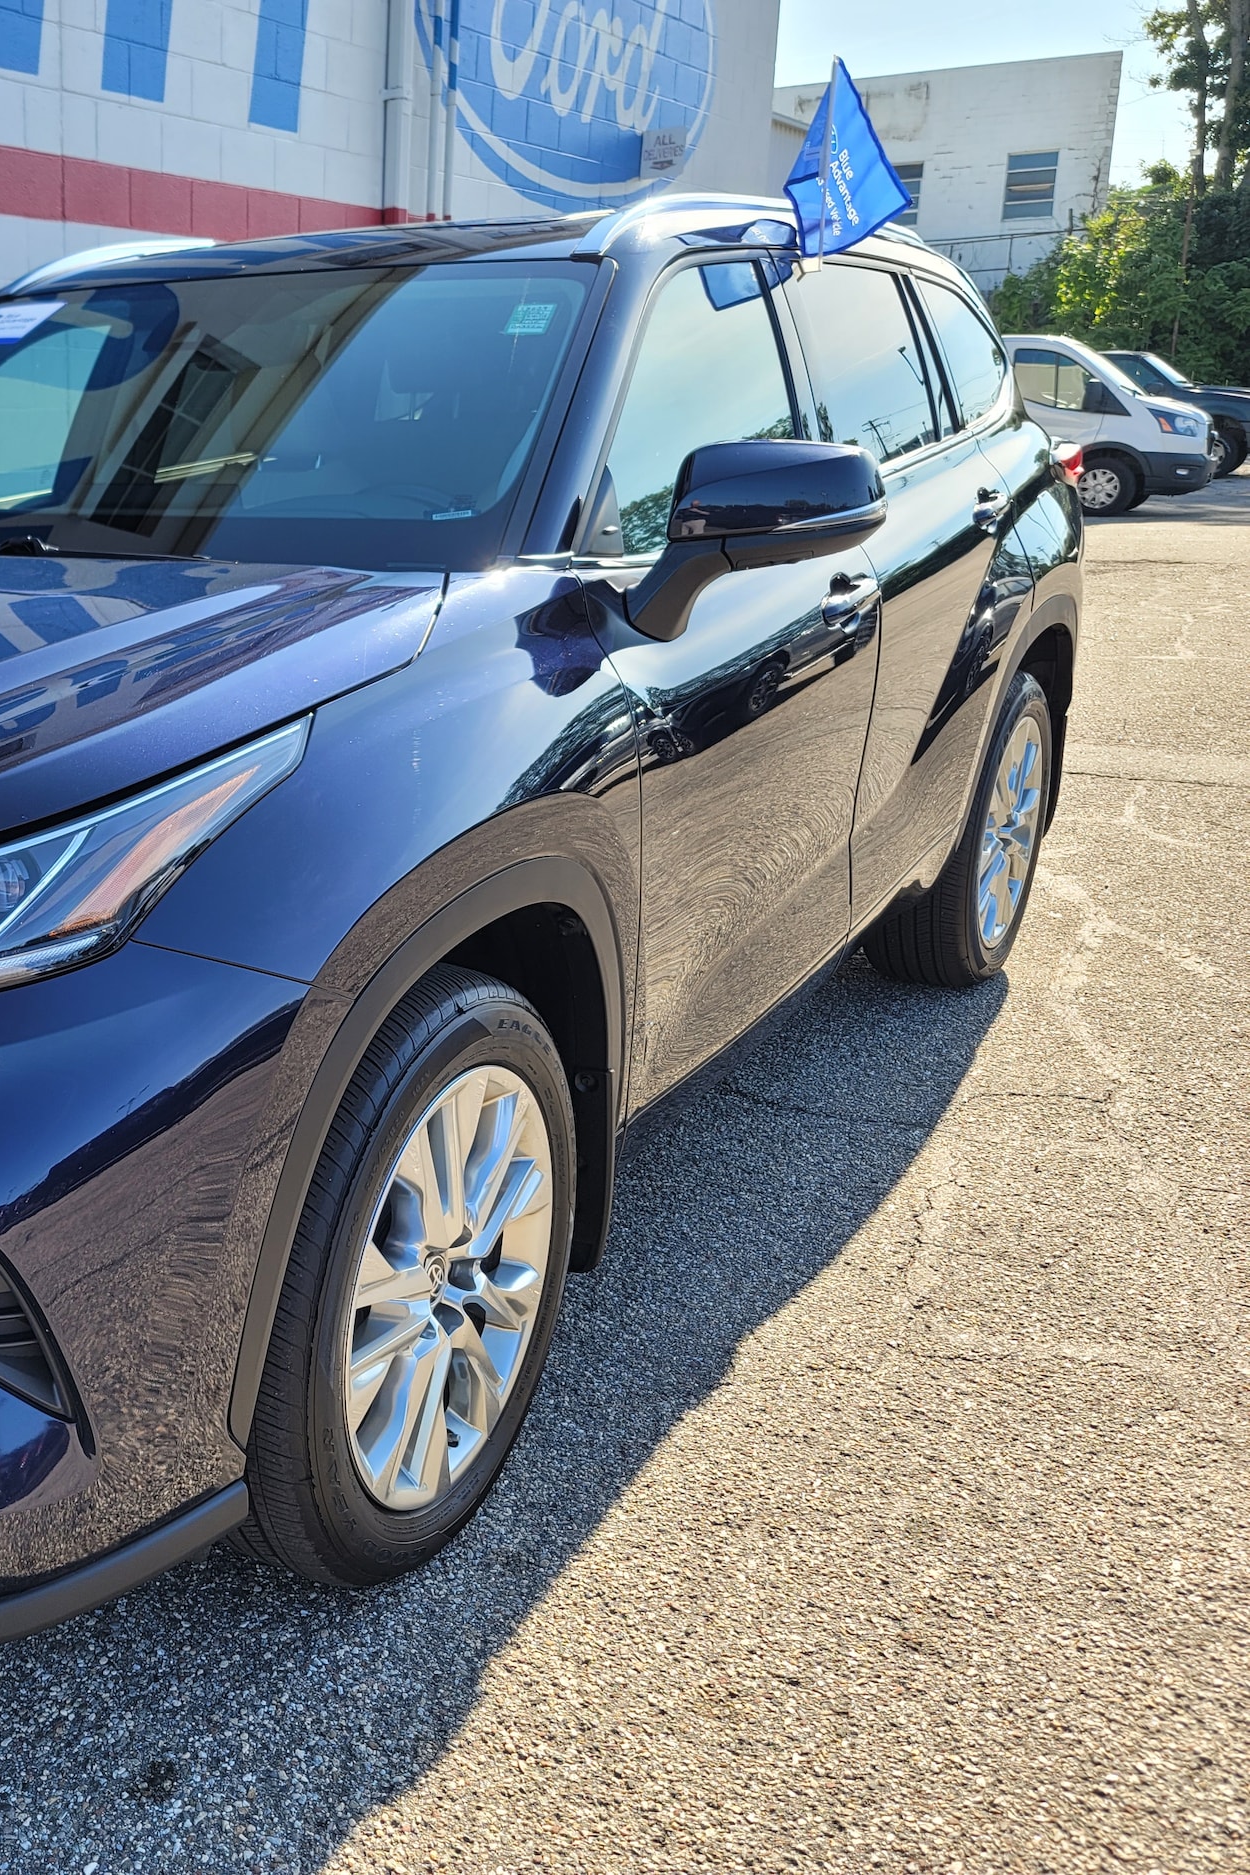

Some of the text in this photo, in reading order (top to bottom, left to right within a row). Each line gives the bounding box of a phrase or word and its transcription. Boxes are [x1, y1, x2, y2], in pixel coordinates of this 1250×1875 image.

[654, 134, 676, 148] ALL
[838, 148, 854, 180] Blue
[830, 160, 860, 226] Advantage
[497, 1018, 552, 1056] EAGLE
